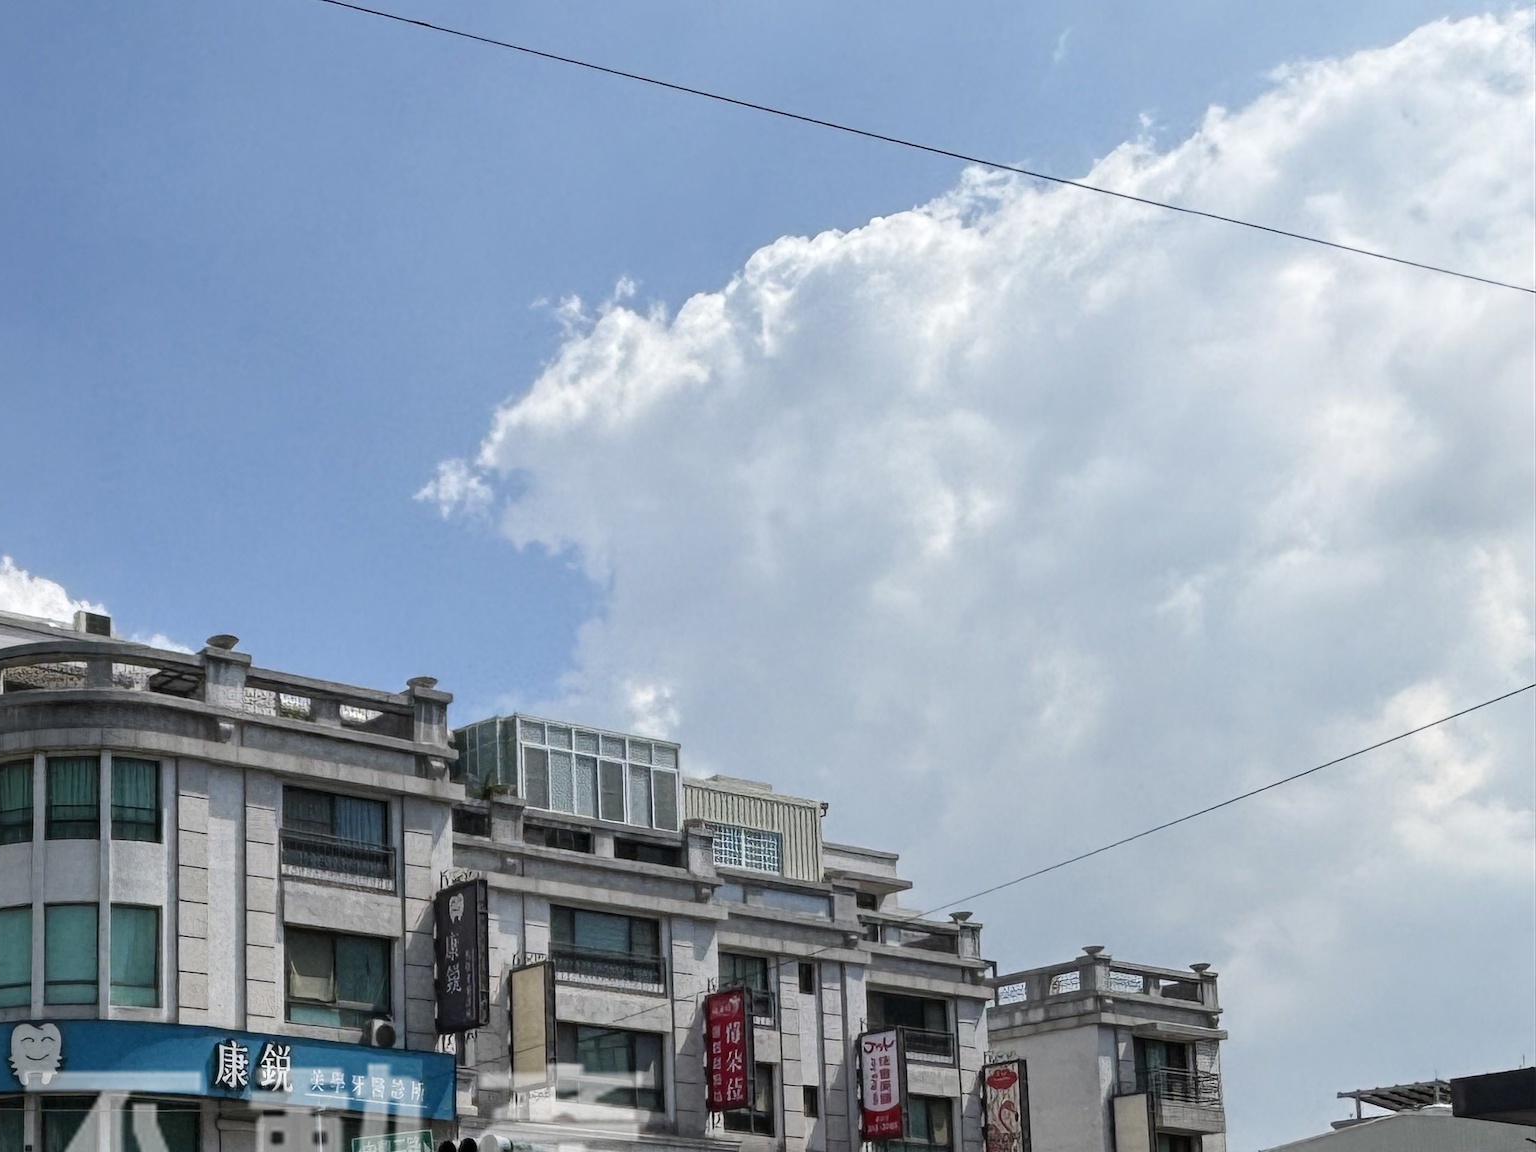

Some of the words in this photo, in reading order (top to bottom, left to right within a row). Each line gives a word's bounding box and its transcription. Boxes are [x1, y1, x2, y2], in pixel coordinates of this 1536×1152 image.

[310, 1068, 425, 1101] 美學牙醫診所
